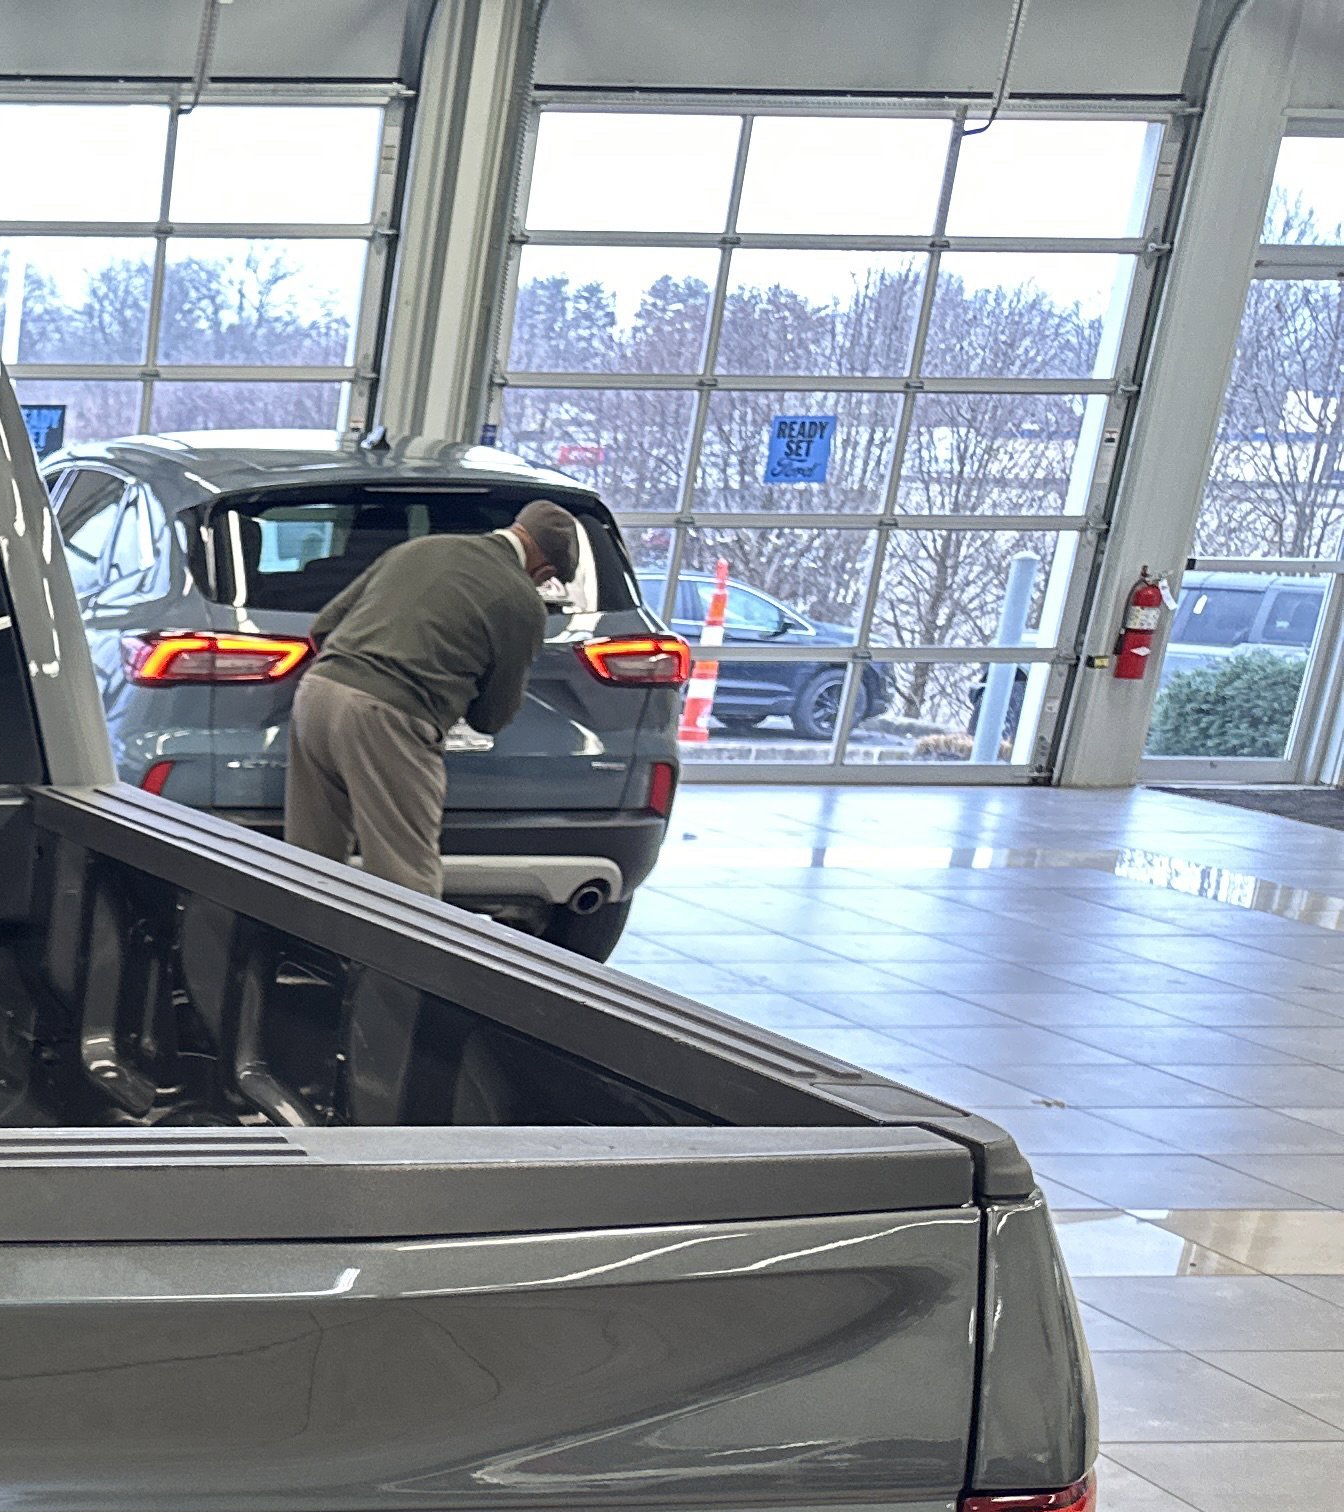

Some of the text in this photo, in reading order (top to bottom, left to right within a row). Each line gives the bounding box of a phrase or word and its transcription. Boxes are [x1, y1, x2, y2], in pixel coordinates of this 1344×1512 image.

[776, 421, 829, 439] READY
[784, 439, 814, 457] SET
[771, 457, 823, 478] Ford
